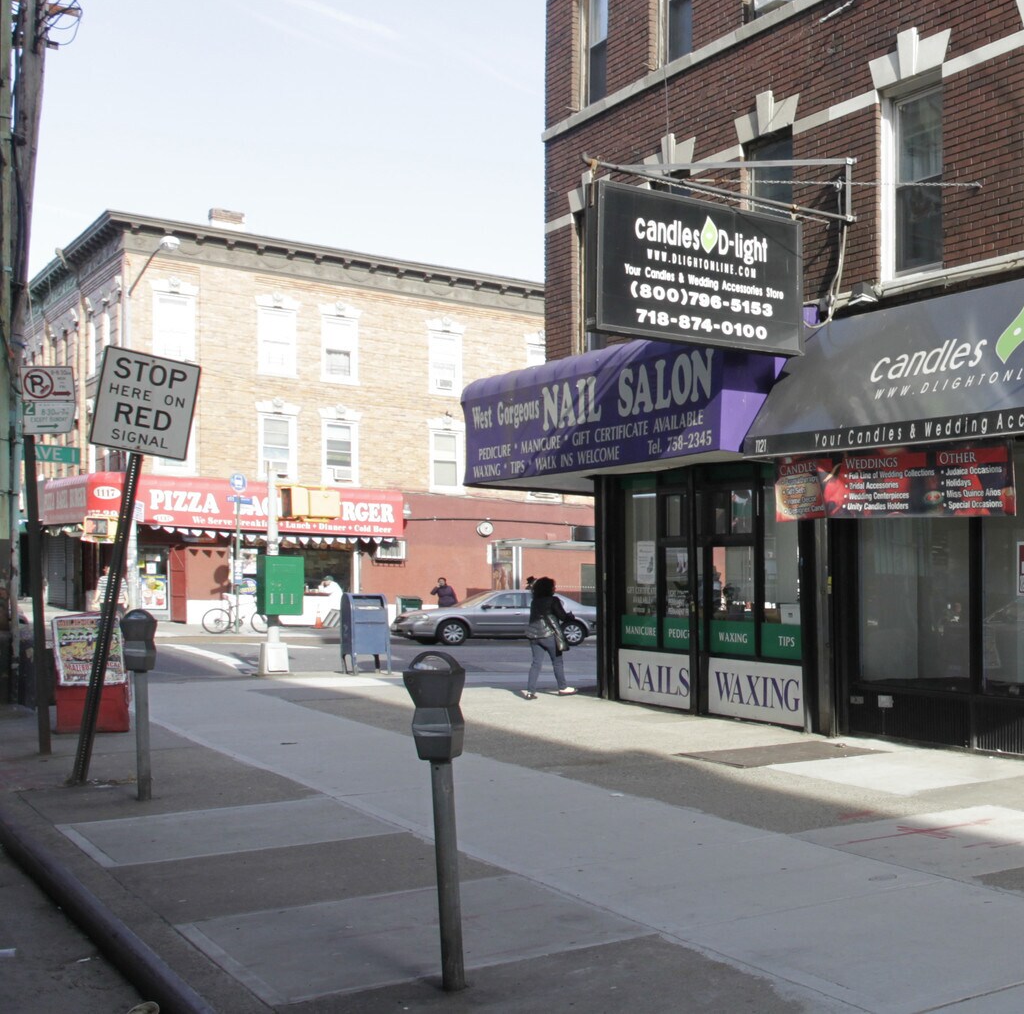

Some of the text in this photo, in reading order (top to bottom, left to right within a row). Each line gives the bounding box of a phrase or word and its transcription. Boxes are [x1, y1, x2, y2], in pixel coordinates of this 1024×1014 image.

[635, 217, 768, 265] candles D-light
[647, 249, 757, 279] WWW.DLIGHTONLINE.COM
[624, 263, 784, 300] Your Candles & Wedding Accessories Store
[630, 281, 774, 317] (800)796-5153
[636, 308, 768, 340] 718-874-0100
[870, 338, 987, 383] candles
[113, 357, 188, 389] STOP
[109, 383, 186, 408] HERE ON
[472, 348, 714, 431] West Gorgeous NAIL SALON
[25, 403, 34, 415] 2
[114, 402, 172, 431] RED
[111, 429, 168, 449] SIGNAL
[478, 409, 704, 461] PEDICURE MANICURE GIFT CERTIFICATE AVAILABLE
[815, 433, 841, 448] Your
[848, 427, 902, 445] Candles
[909, 424, 916, 437] &
[925, 417, 988, 438] Wedding
[35, 446, 63, 461] AVE
[647, 439, 662, 455] Tel.
[755, 439, 767, 453] 1121
[472, 446, 620, 479] WAXING TIPS WALK INS WELCOME
[845, 458, 898, 469] WEDDINGS
[940, 452, 977, 464] OTHER
[780, 461, 817, 476] CANDLES
[879, 470, 903, 479] Wedding
[904, 469, 935, 477] Collections
[946, 466, 1002, 476] Judaica Occasions
[866, 481, 899, 489] Accessories
[946, 479, 972, 487] Holidays
[848, 491, 909, 501] Wedding Centerpieces
[946, 488, 1001, 498] Miss Quince Años
[149, 489, 220, 514] PIZZA
[847, 503, 862, 512] Unity
[864, 502, 886, 510] Candles
[948, 499, 1003, 510] Special Occasions
[192, 516, 206, 525] We
[208, 517, 233, 526] Serve
[285, 522, 311, 530] Lunch
[318, 523, 346, 532] Dinner
[354, 524, 372, 532] Cold
[625, 625, 657, 637] MANICURE
[668, 628, 690, 639] PEDIC
[718, 631, 748, 644] WAXING
[778, 636, 795, 648] TIPS
[627, 661, 690, 698] NAILS
[715, 670, 800, 712] WAXING
